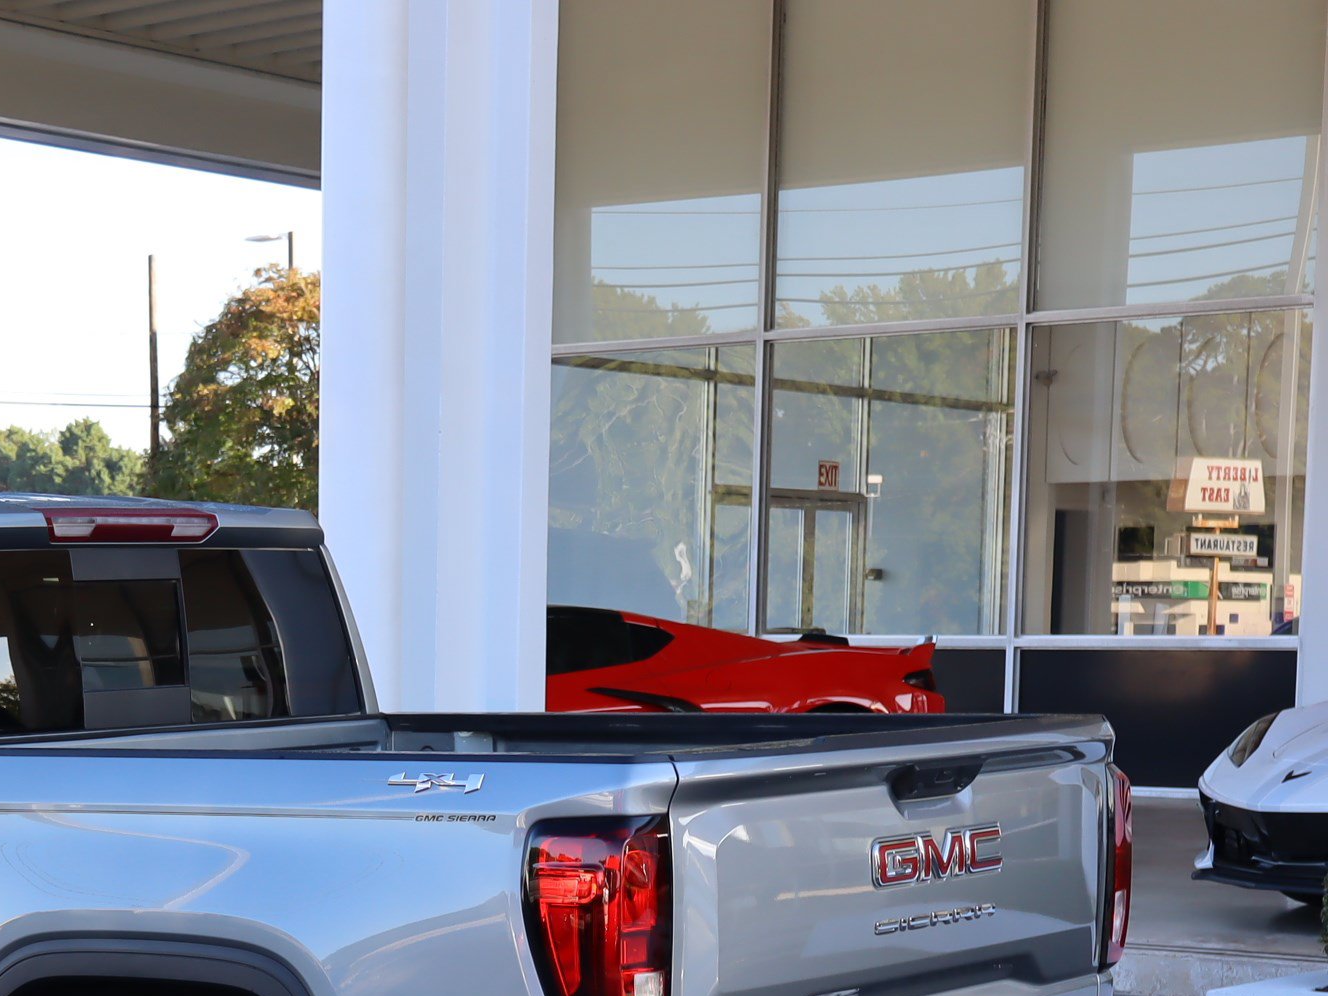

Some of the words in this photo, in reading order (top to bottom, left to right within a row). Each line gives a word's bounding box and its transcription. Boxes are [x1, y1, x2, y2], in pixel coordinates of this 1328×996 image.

[818, 464, 839, 486] EXIT
[872, 821, 1004, 889] GMC
[874, 903, 998, 936] SIERRA
